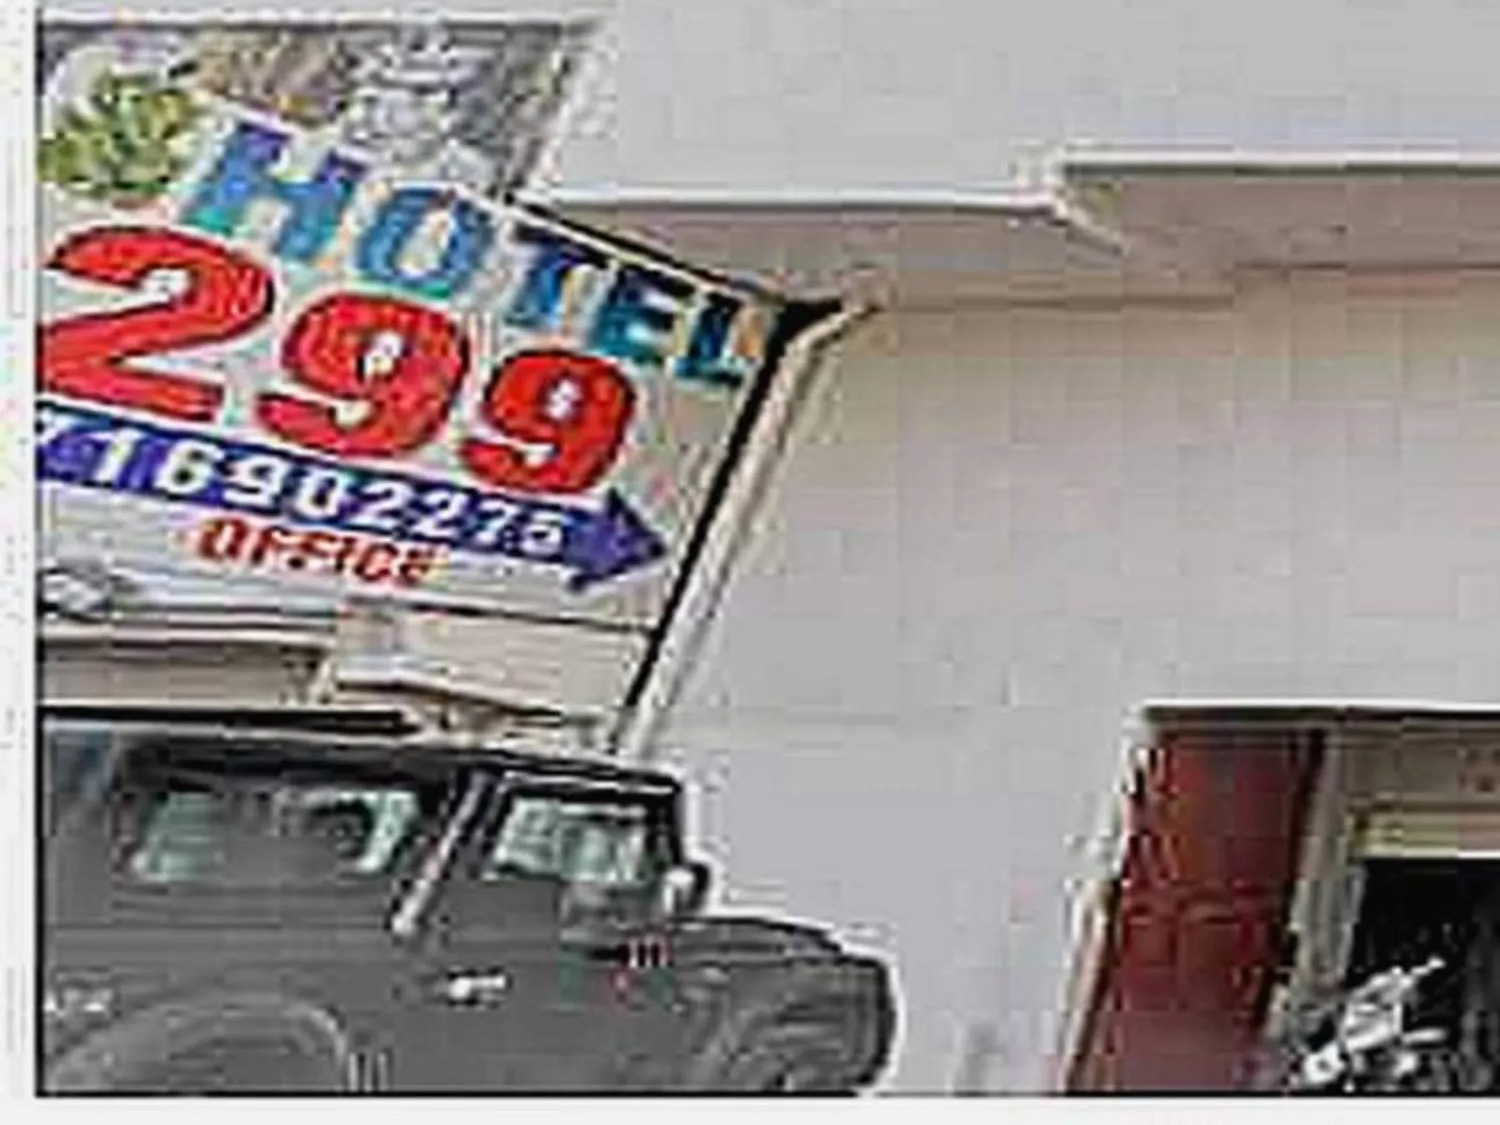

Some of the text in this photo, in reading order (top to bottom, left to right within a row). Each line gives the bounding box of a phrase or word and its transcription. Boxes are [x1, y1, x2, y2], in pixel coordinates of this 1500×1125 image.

[180, 119, 748, 387] HOTEL
[38, 225, 638, 497] 299
[38, 413, 566, 553] 16902275
[193, 517, 446, 587] OFFICE
